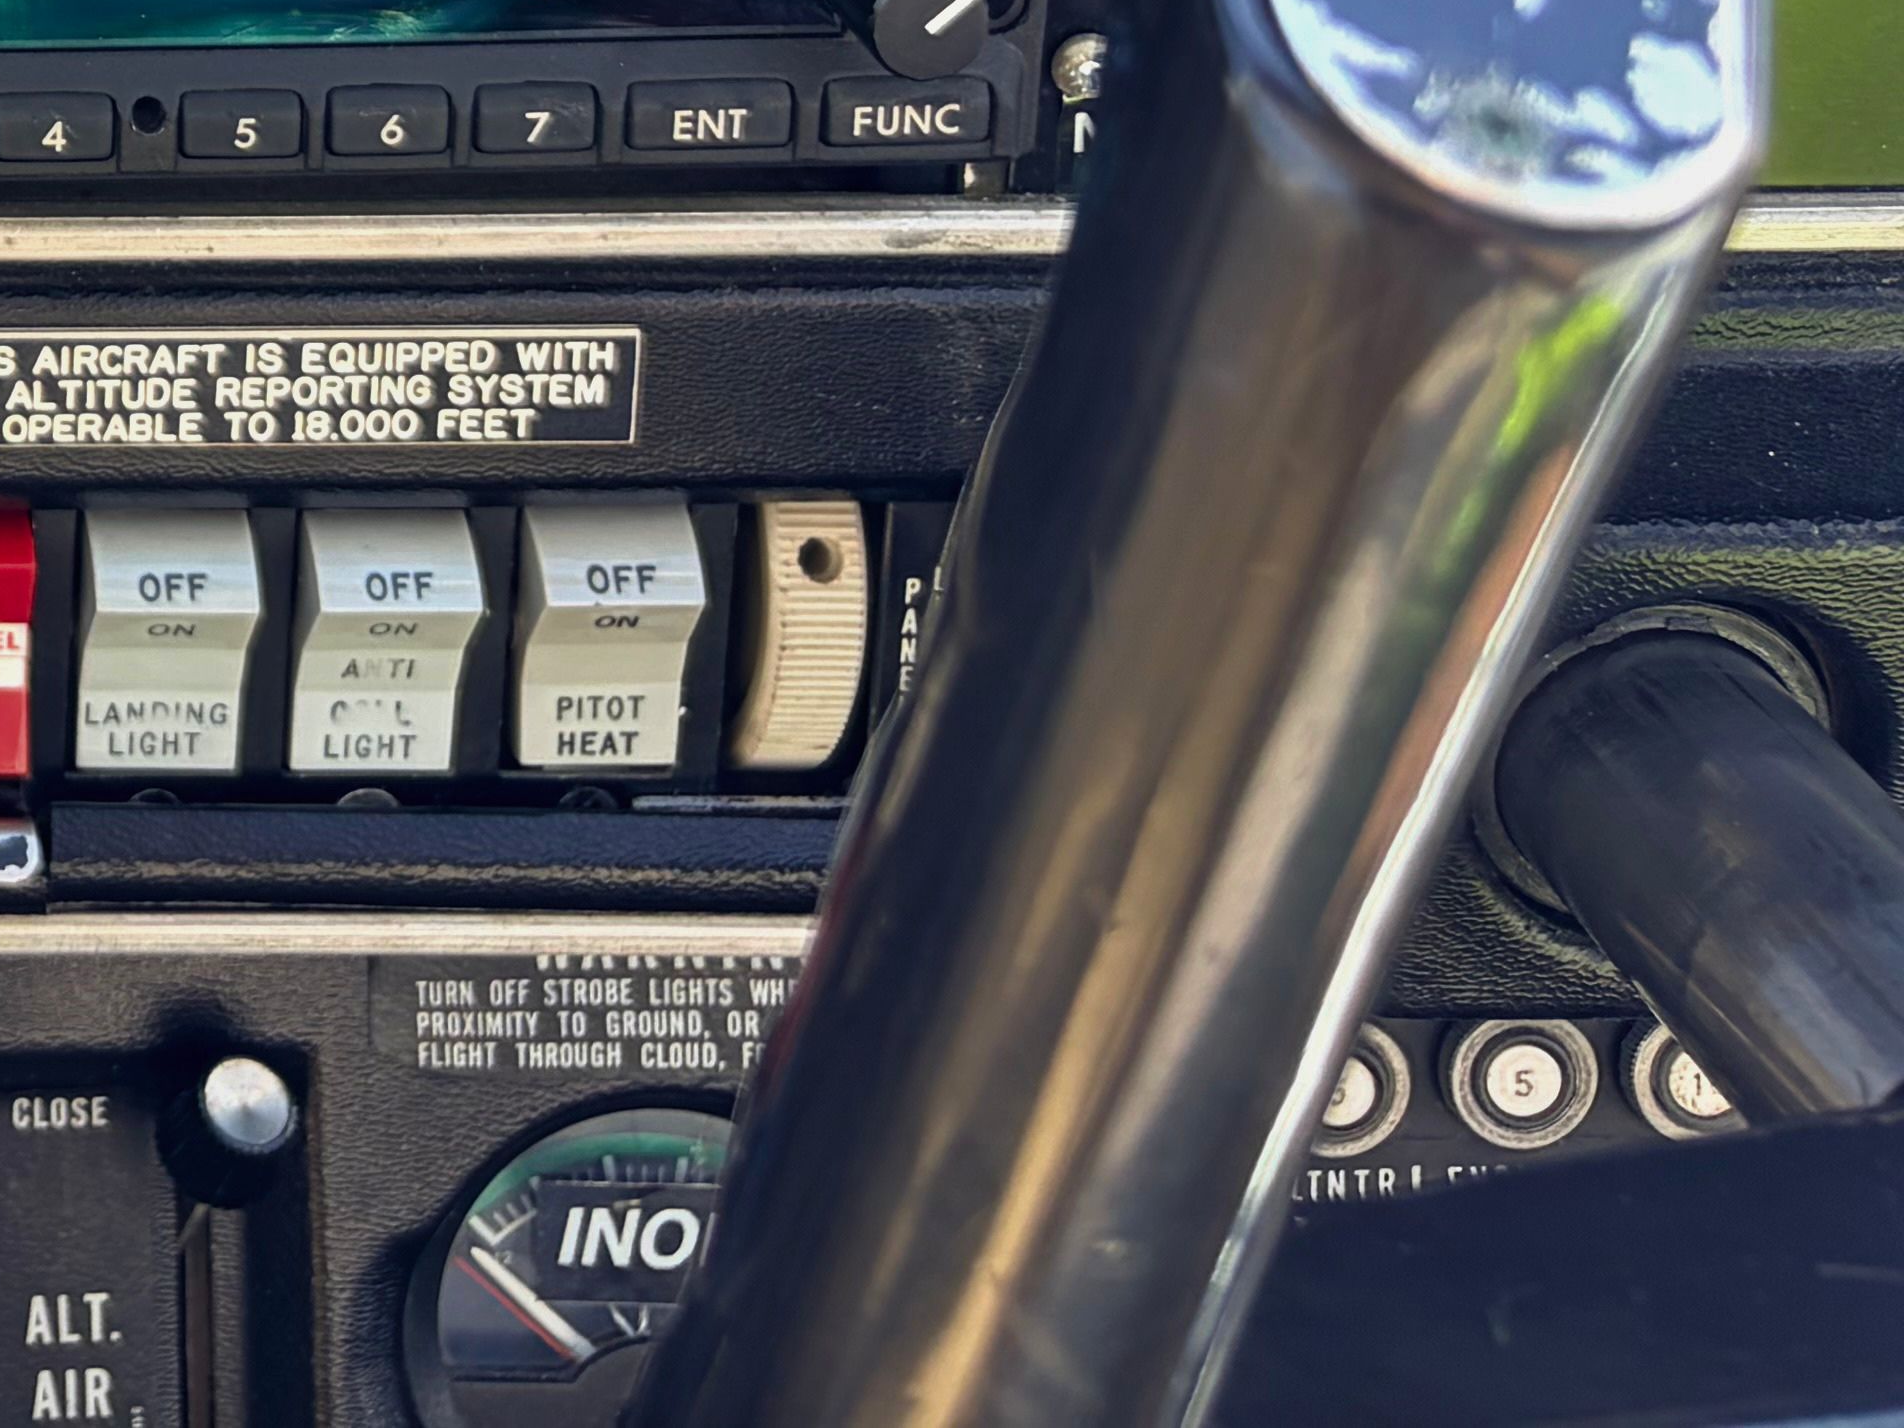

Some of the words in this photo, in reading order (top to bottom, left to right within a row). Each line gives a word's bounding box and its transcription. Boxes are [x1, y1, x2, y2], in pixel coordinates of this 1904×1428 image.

[852, 103, 962, 136] FUNC
[32, 345, 224, 375] AIRCRAFT
[245, 344, 283, 374] IS
[301, 342, 498, 375] EQUIPPED
[515, 341, 616, 373] WITH
[555, 695, 646, 721] PITOT
[556, 731, 640, 757] HEAT
[415, 980, 476, 1008] TURN
[489, 979, 530, 1007] OFF
[543, 978, 635, 1007] STROBE
[648, 977, 733, 1007] LIGHTS
[11, 1095, 109, 1129] CLOSE
[26, 1293, 123, 1347] ALT.
[31, 1368, 113, 1421] AIR
